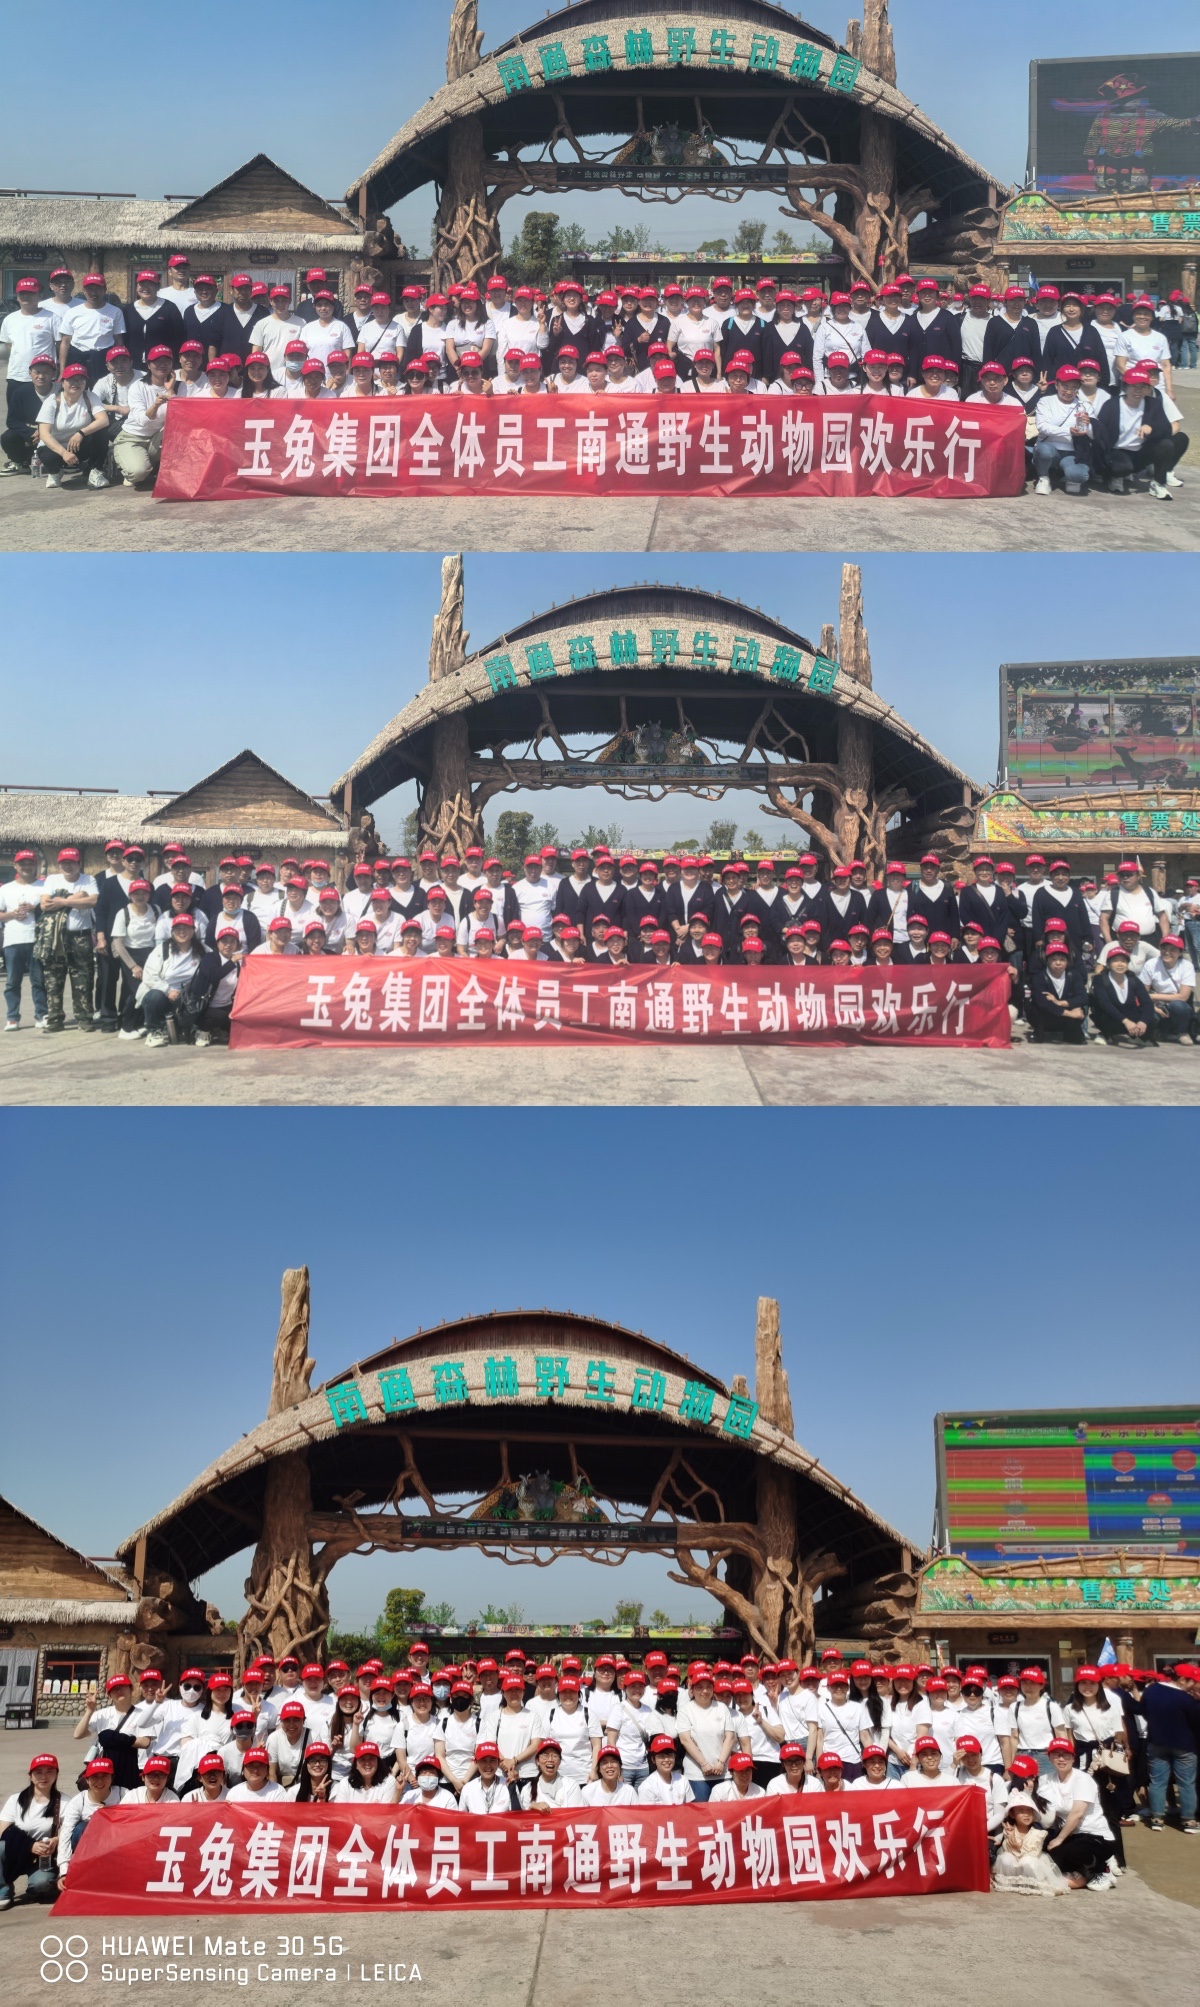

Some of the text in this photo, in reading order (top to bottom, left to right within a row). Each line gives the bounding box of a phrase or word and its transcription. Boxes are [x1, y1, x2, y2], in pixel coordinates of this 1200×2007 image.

[497, 27, 862, 94] 南通森林野生动物园
[237, 411, 982, 482] 玉兔集团全体员工南通野生动物园欢乐行
[484, 629, 840, 694] 南通森林野生动物园
[1120, 811, 1200, 831] 售票处
[301, 972, 973, 1036] 玉兔集团全体员工南通野生动物园欢乐行
[325, 1356, 759, 1440] 南通森林野生动物园
[1079, 1578, 1172, 1602] 售票处
[145, 1807, 947, 1899] 玉兔集团全体员工南通野生动物园欢乐行
